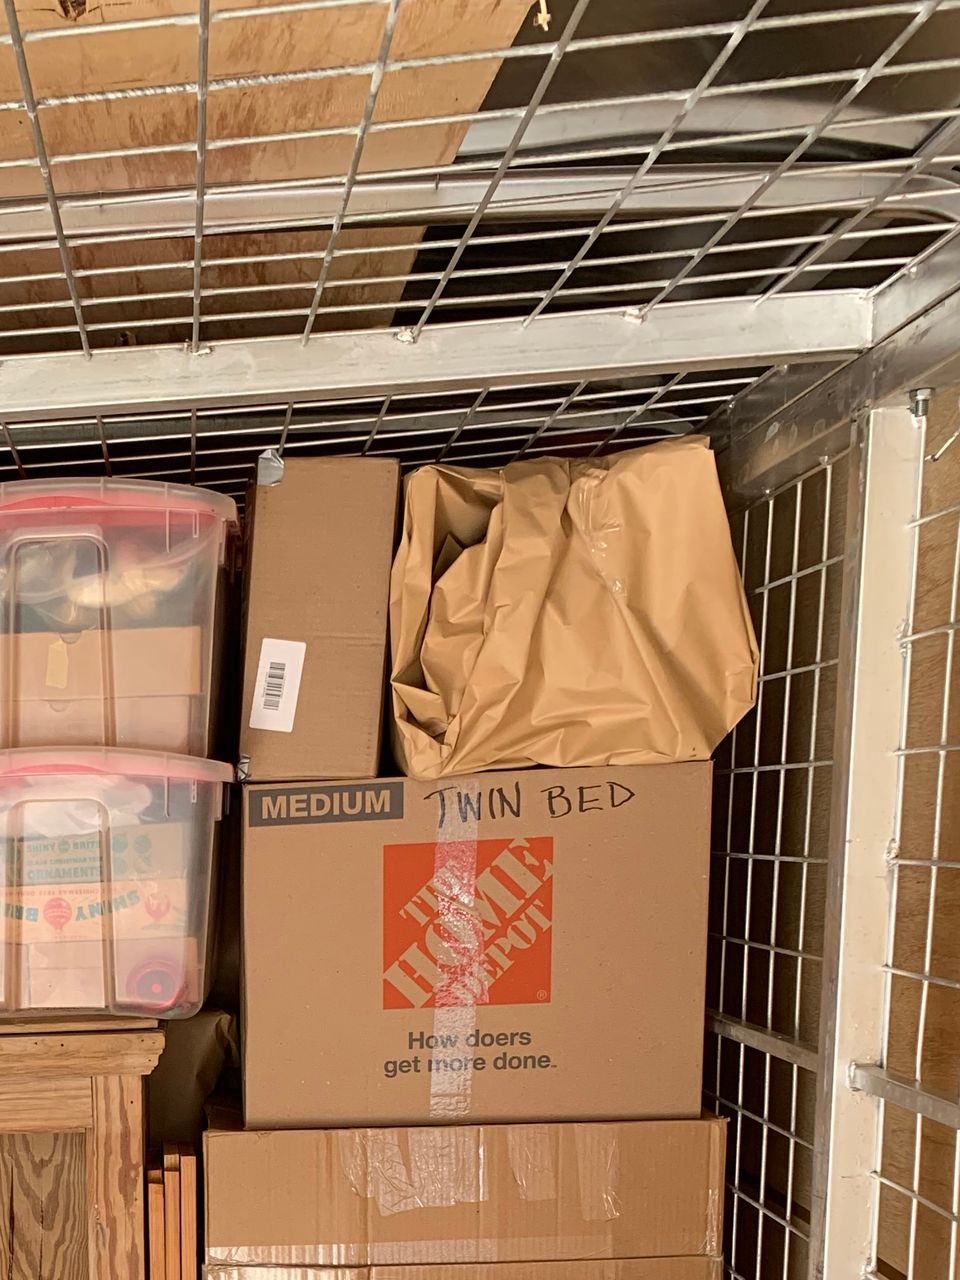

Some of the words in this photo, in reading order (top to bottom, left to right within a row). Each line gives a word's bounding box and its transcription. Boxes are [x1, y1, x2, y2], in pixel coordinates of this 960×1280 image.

[261, 789, 390, 819] MEDIUM
[424, 781, 521, 829] TWIN
[541, 781, 636, 819] BED
[383, 838, 553, 1008] HOME
[407, 1031, 458, 1050] How
[465, 1029, 531, 1047] doers
[383, 1057, 421, 1078] get
[427, 1055, 486, 1073] more
